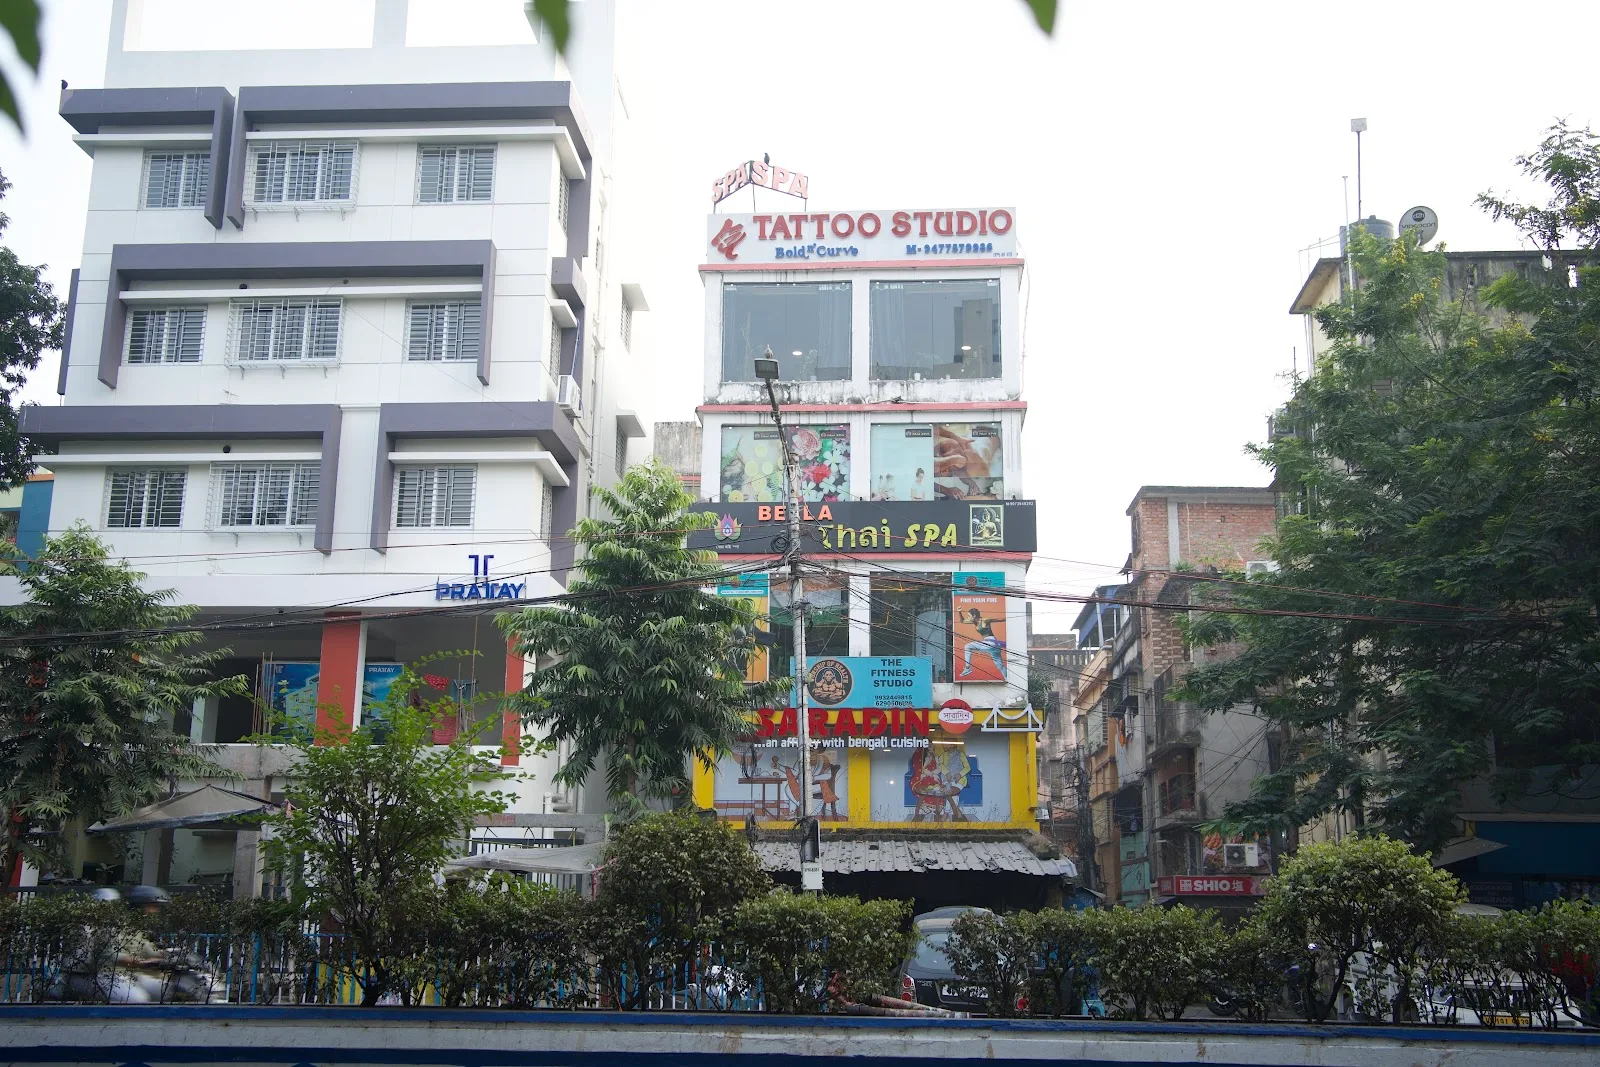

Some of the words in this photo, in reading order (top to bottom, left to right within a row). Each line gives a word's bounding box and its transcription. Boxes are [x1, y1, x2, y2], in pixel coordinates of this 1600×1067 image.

[711, 162, 748, 203] SPA
[751, 160, 808, 199] SPA
[753, 212, 881, 241] TATTOO
[892, 209, 1013, 238] STUDIO
[775, 246, 809, 259] Bold
[817, 245, 859, 258] Curve
[758, 505, 833, 521] BELA
[818, 518, 891, 549] Thai
[904, 523, 957, 548] SPA
[871, 669, 916, 677] FITNESS
[754, 708, 930, 737] SARADIN
[821, 736, 845, 748] with
[848, 735, 888, 751] bengali
[890, 737, 929, 748] cuisine
[1193, 879, 1231, 891] SHIO
